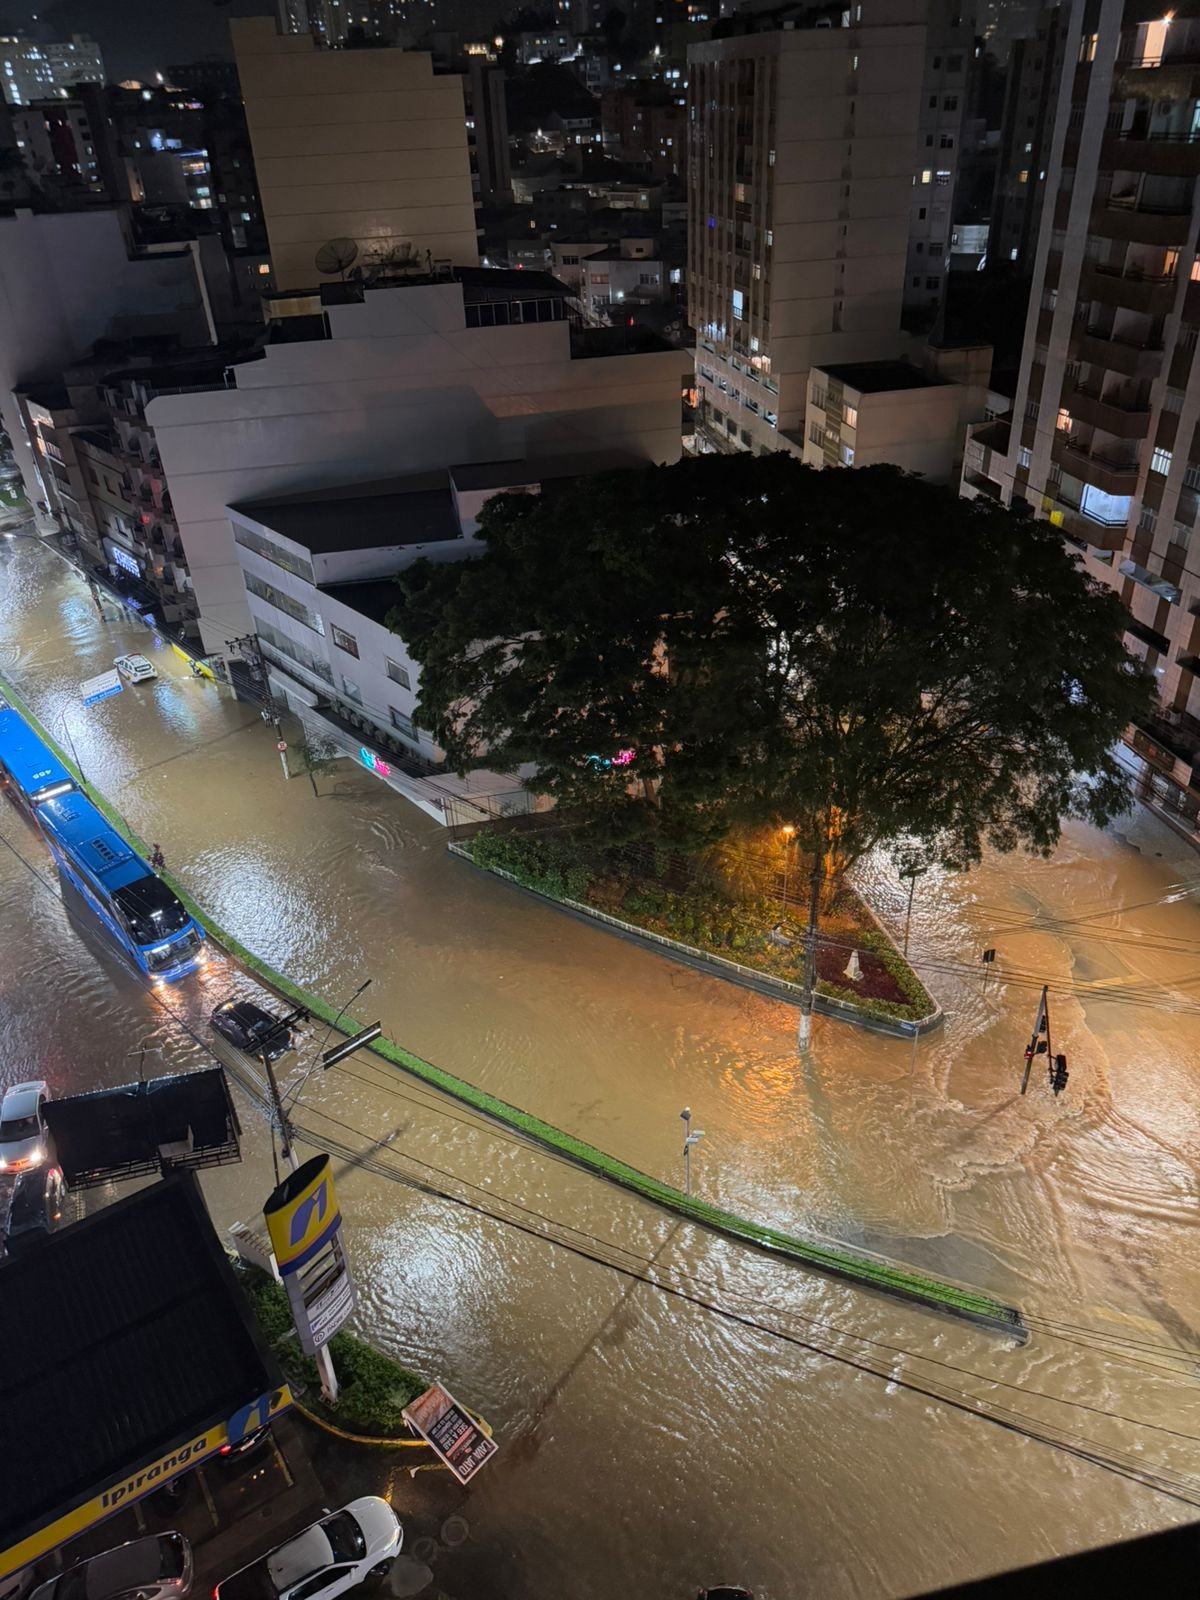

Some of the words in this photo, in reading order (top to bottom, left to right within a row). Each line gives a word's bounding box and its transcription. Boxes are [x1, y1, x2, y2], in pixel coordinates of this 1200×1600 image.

[472, 1440, 492, 1460] LAVA
[101, 1437, 207, 1509] Ipiranga
[458, 1455, 476, 1476] JATO
